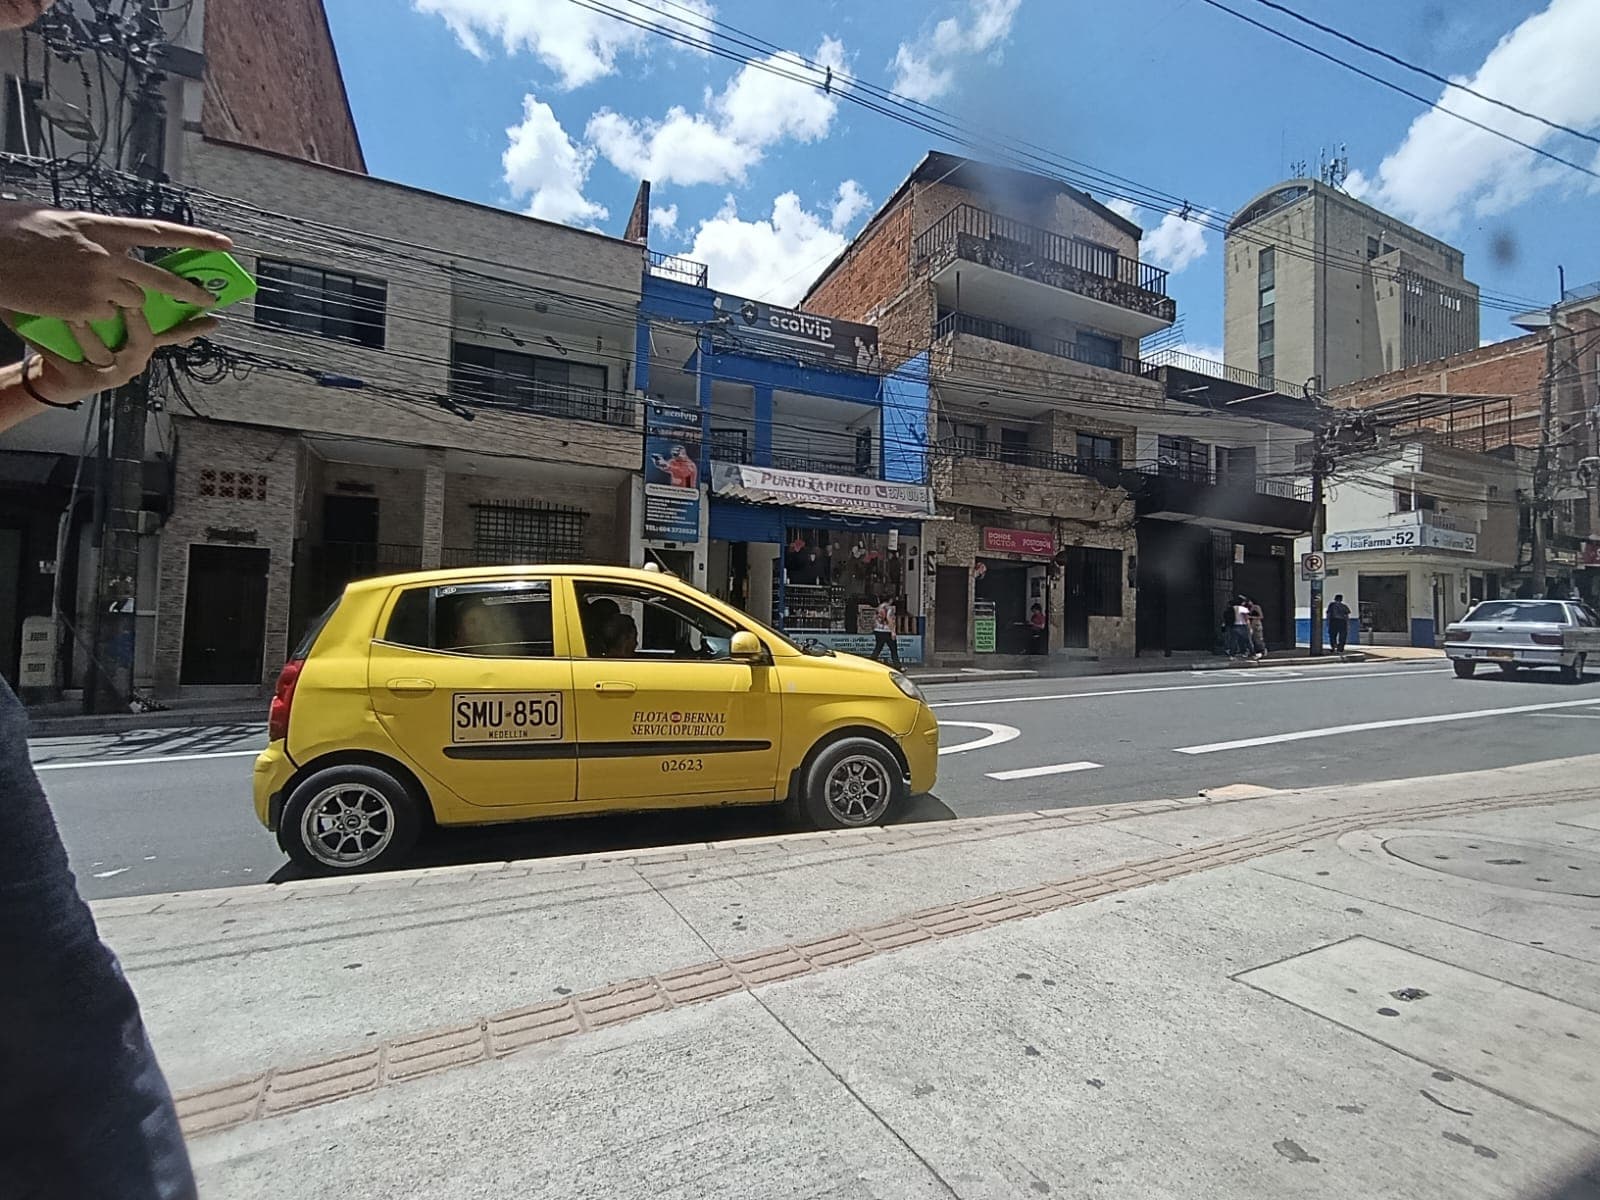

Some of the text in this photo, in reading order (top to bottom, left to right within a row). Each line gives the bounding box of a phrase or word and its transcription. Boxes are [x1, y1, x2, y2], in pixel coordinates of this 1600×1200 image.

[769, 315, 832, 341] ecolvip
[989, 539, 1016, 548] VICTOR
[632, 711, 669, 723] FLOTA
[683, 711, 726, 724] BERNAL
[488, 730, 528, 739] MEDELLIN
[661, 759, 704, 773] 02623
